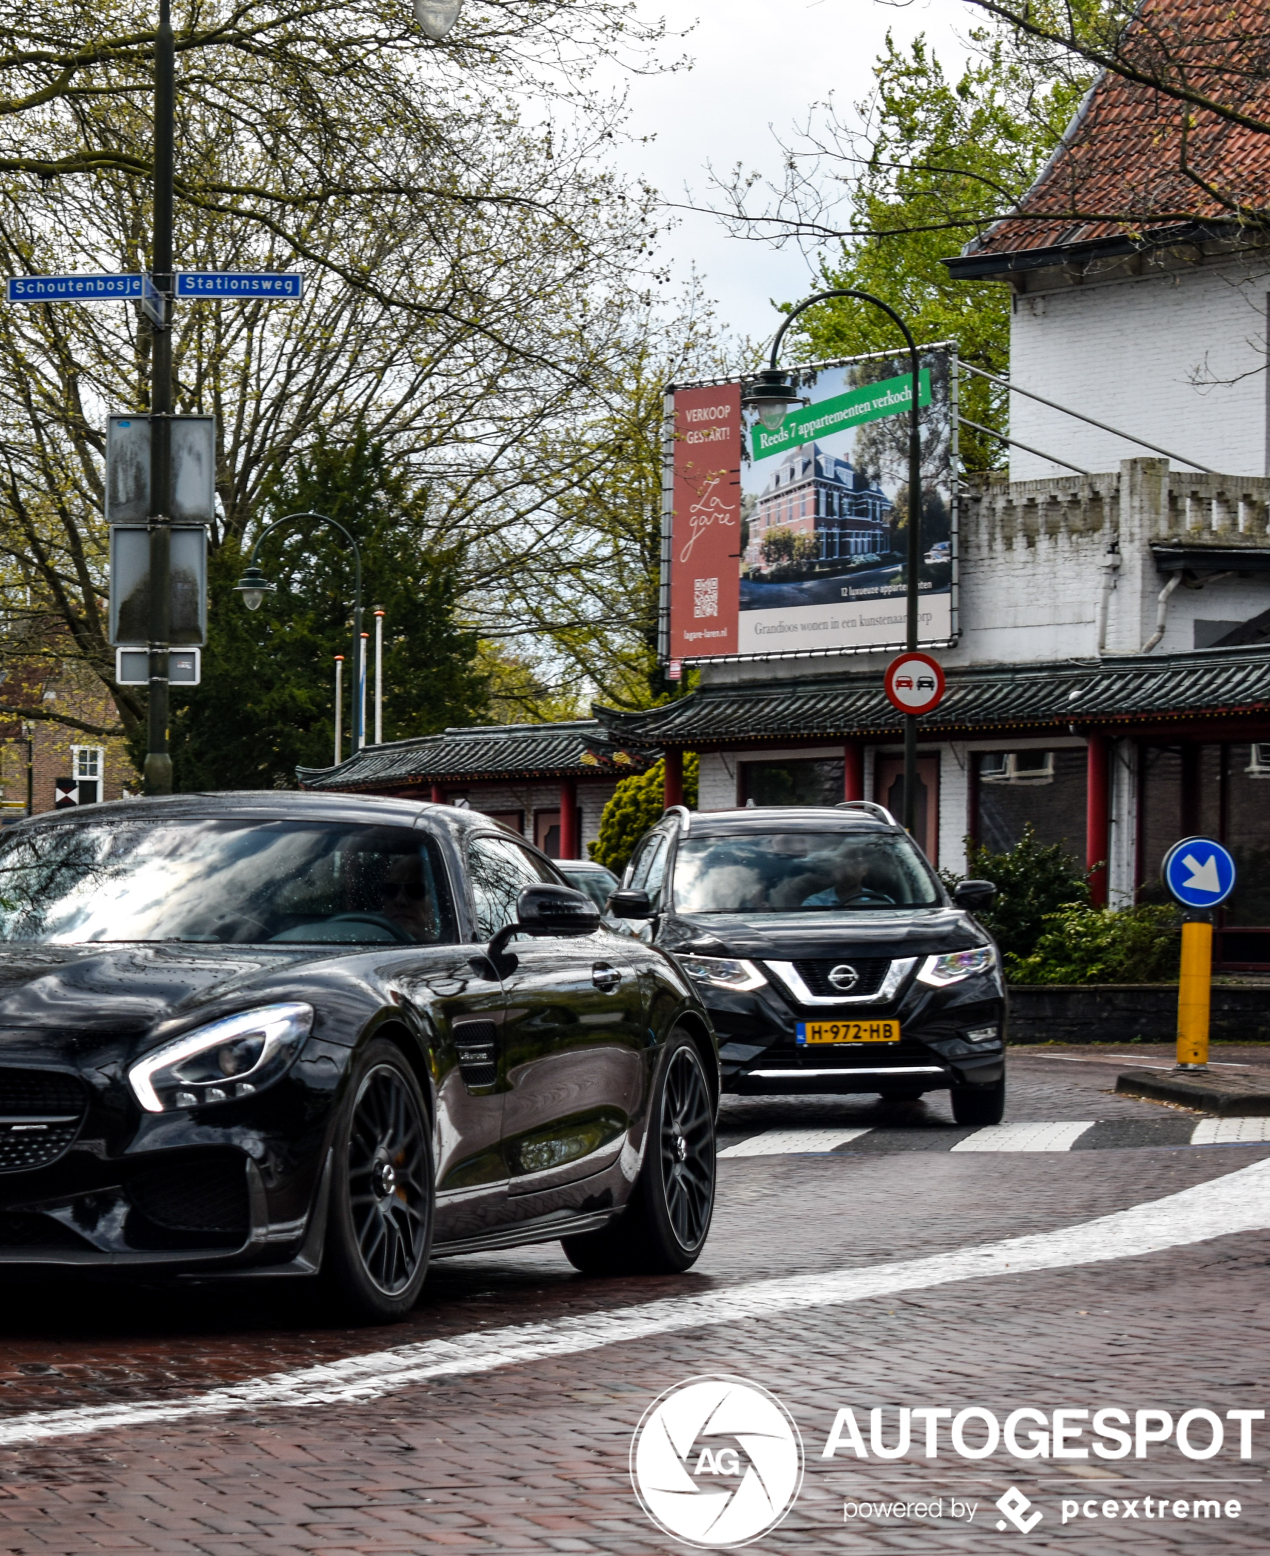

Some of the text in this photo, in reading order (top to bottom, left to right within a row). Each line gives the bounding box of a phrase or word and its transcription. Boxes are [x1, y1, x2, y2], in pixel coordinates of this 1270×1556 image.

[15, 278, 141, 294] Schoutenbosje
[185, 276, 293, 293] Stationsweg
[685, 405, 731, 422] VERKOOP
[759, 382, 923, 449] Reeds 7 appartementen verkoch!
[680, 513, 736, 562] gare
[754, 621, 798, 635] Grandioos
[800, 620, 828, 631] wonen
[831, 617, 840, 629] in
[841, 617, 857, 628] een
[811, 1024, 893, 1040] H-972-HB
